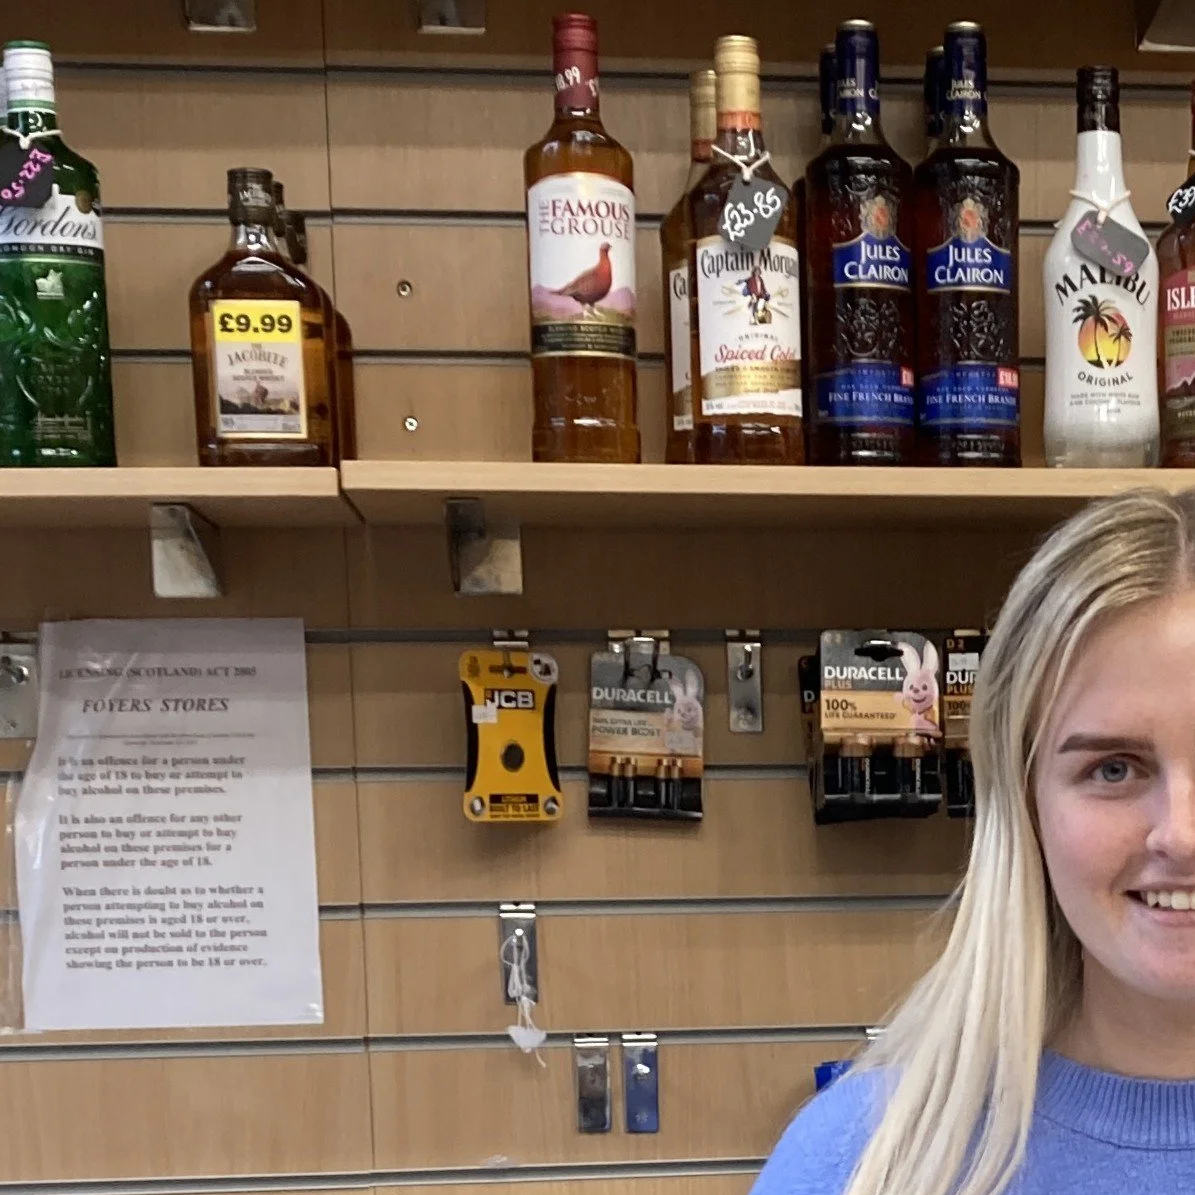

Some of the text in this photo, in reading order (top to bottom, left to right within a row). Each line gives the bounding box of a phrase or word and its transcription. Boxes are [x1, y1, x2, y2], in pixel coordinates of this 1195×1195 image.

[551, 199, 630, 222] FAMOUS
[722, 187, 782, 241] £23.85
[551, 218, 630, 240] GROUSE
[861, 241, 900, 264] JULES
[949, 244, 992, 268] JULES
[701, 249, 755, 279] Captain
[844, 261, 909, 283] CLAIRON
[935, 268, 1004, 285] CLAIRON
[1055, 263, 1150, 306] MALIBU
[219, 313, 293, 333] £9.99
[714, 344, 765, 363] Spiced
[1077, 371, 1134, 388] ORIGINAL
[853, 392, 891, 402] FRENCH
[946, 393, 986, 404] FRENCH
[824, 666, 904, 681] DURACELL
[825, 681, 852, 690] PLUS
[491, 690, 535, 708] JCB
[591, 687, 673, 704] DURACELL
[82, 698, 230, 713] FOYERS STORES
[825, 699, 857, 711] 100%
